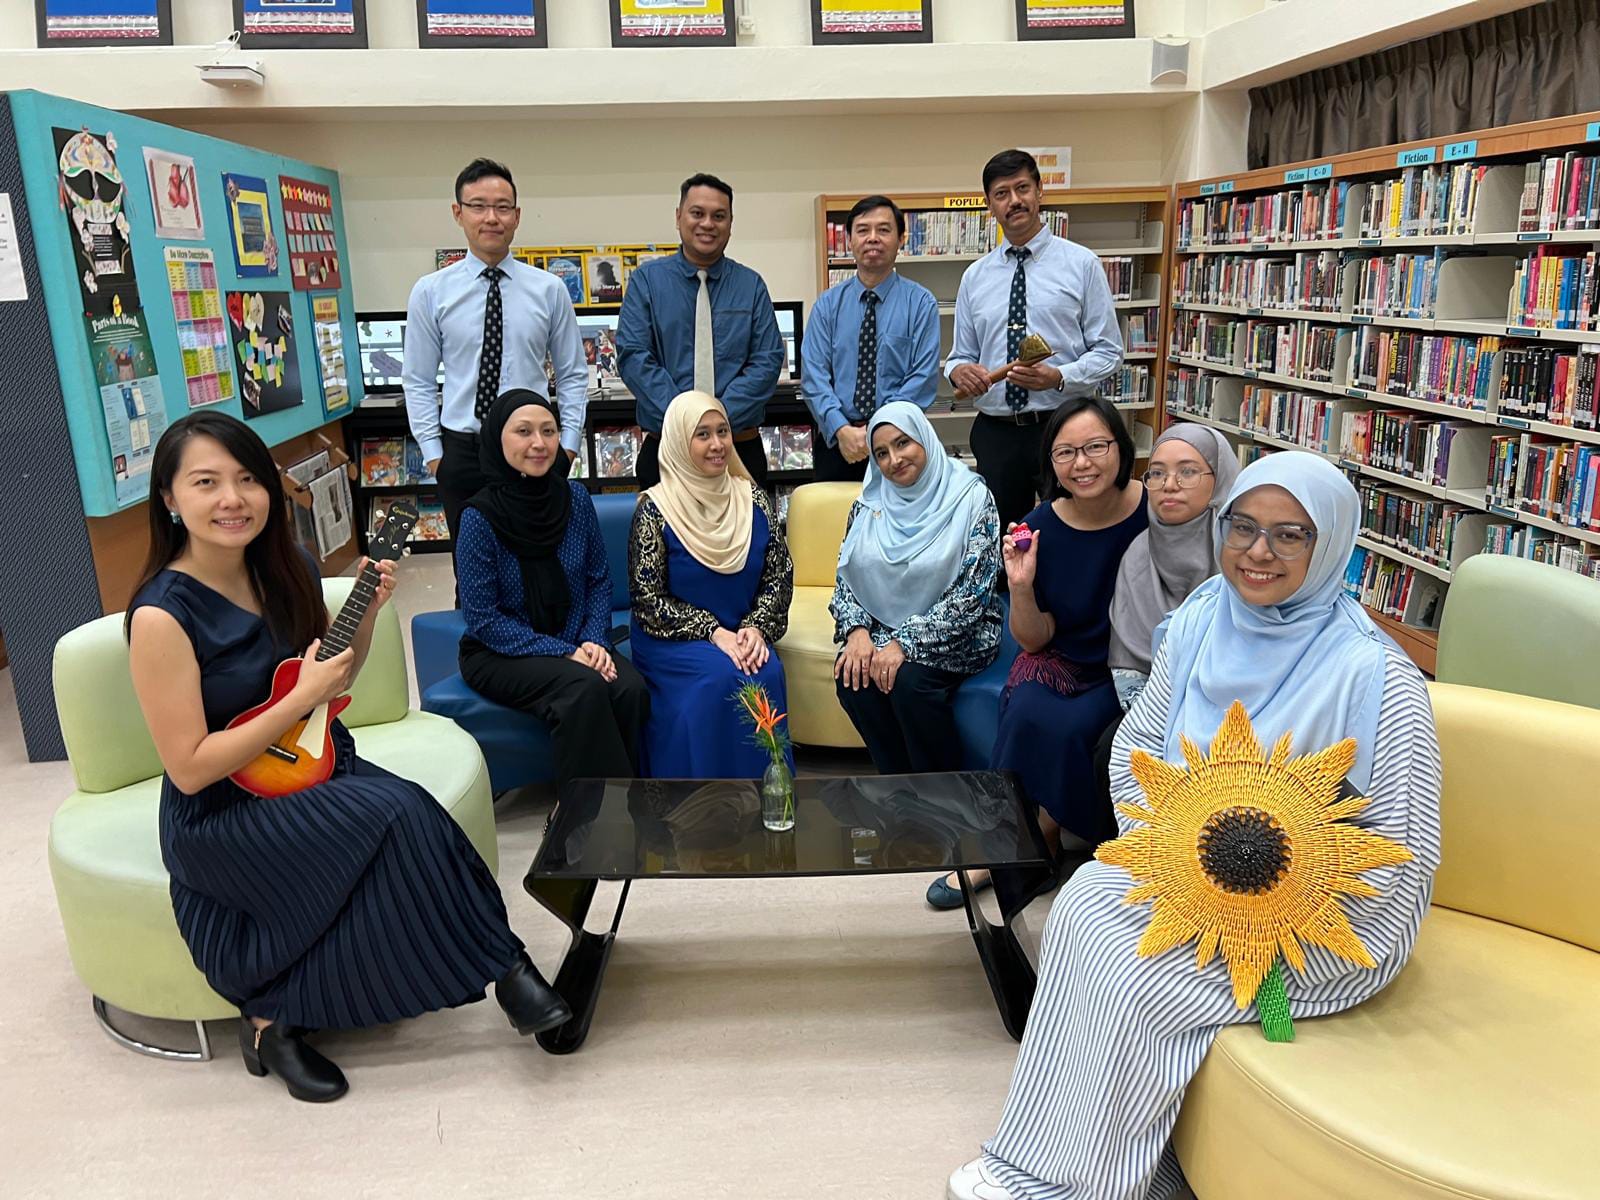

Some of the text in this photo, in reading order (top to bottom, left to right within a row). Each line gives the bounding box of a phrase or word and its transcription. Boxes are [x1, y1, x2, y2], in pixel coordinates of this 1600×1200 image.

[1451, 146, 1457, 156] E
[1403, 153, 1429, 165] Fiction
[1287, 173, 1305, 182] Fiction
[949, 198, 988, 207] POPULA
[92, 318, 109, 334] Parts
[122, 312, 140, 328] Book
